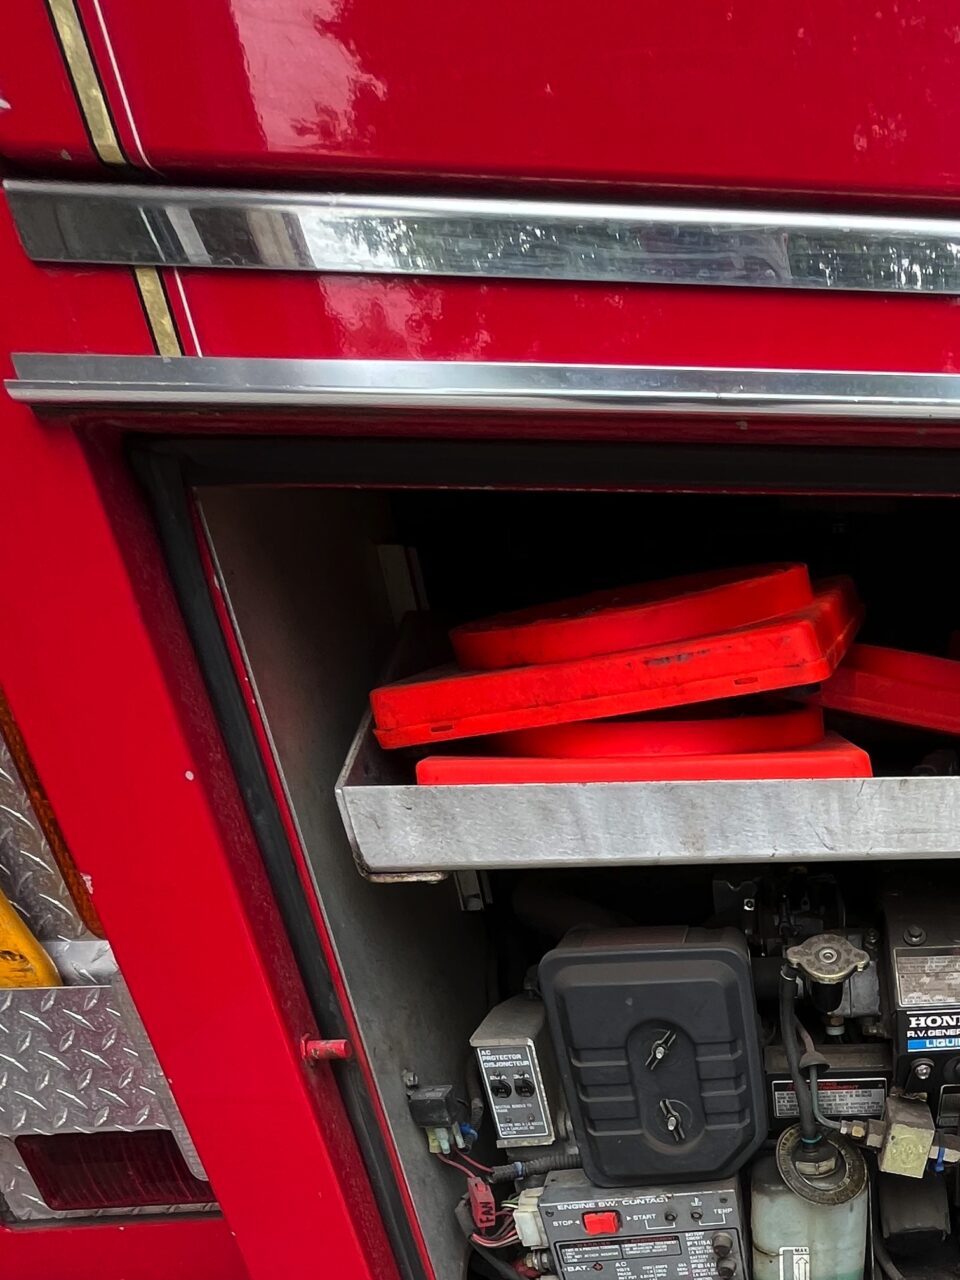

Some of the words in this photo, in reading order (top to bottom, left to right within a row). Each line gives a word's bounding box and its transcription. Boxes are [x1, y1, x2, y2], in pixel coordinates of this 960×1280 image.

[480, 1201, 494, 1224] FAN
[557, 1202, 596, 1210] ENGINE
[622, 1198, 669, 1206] CONTACT
